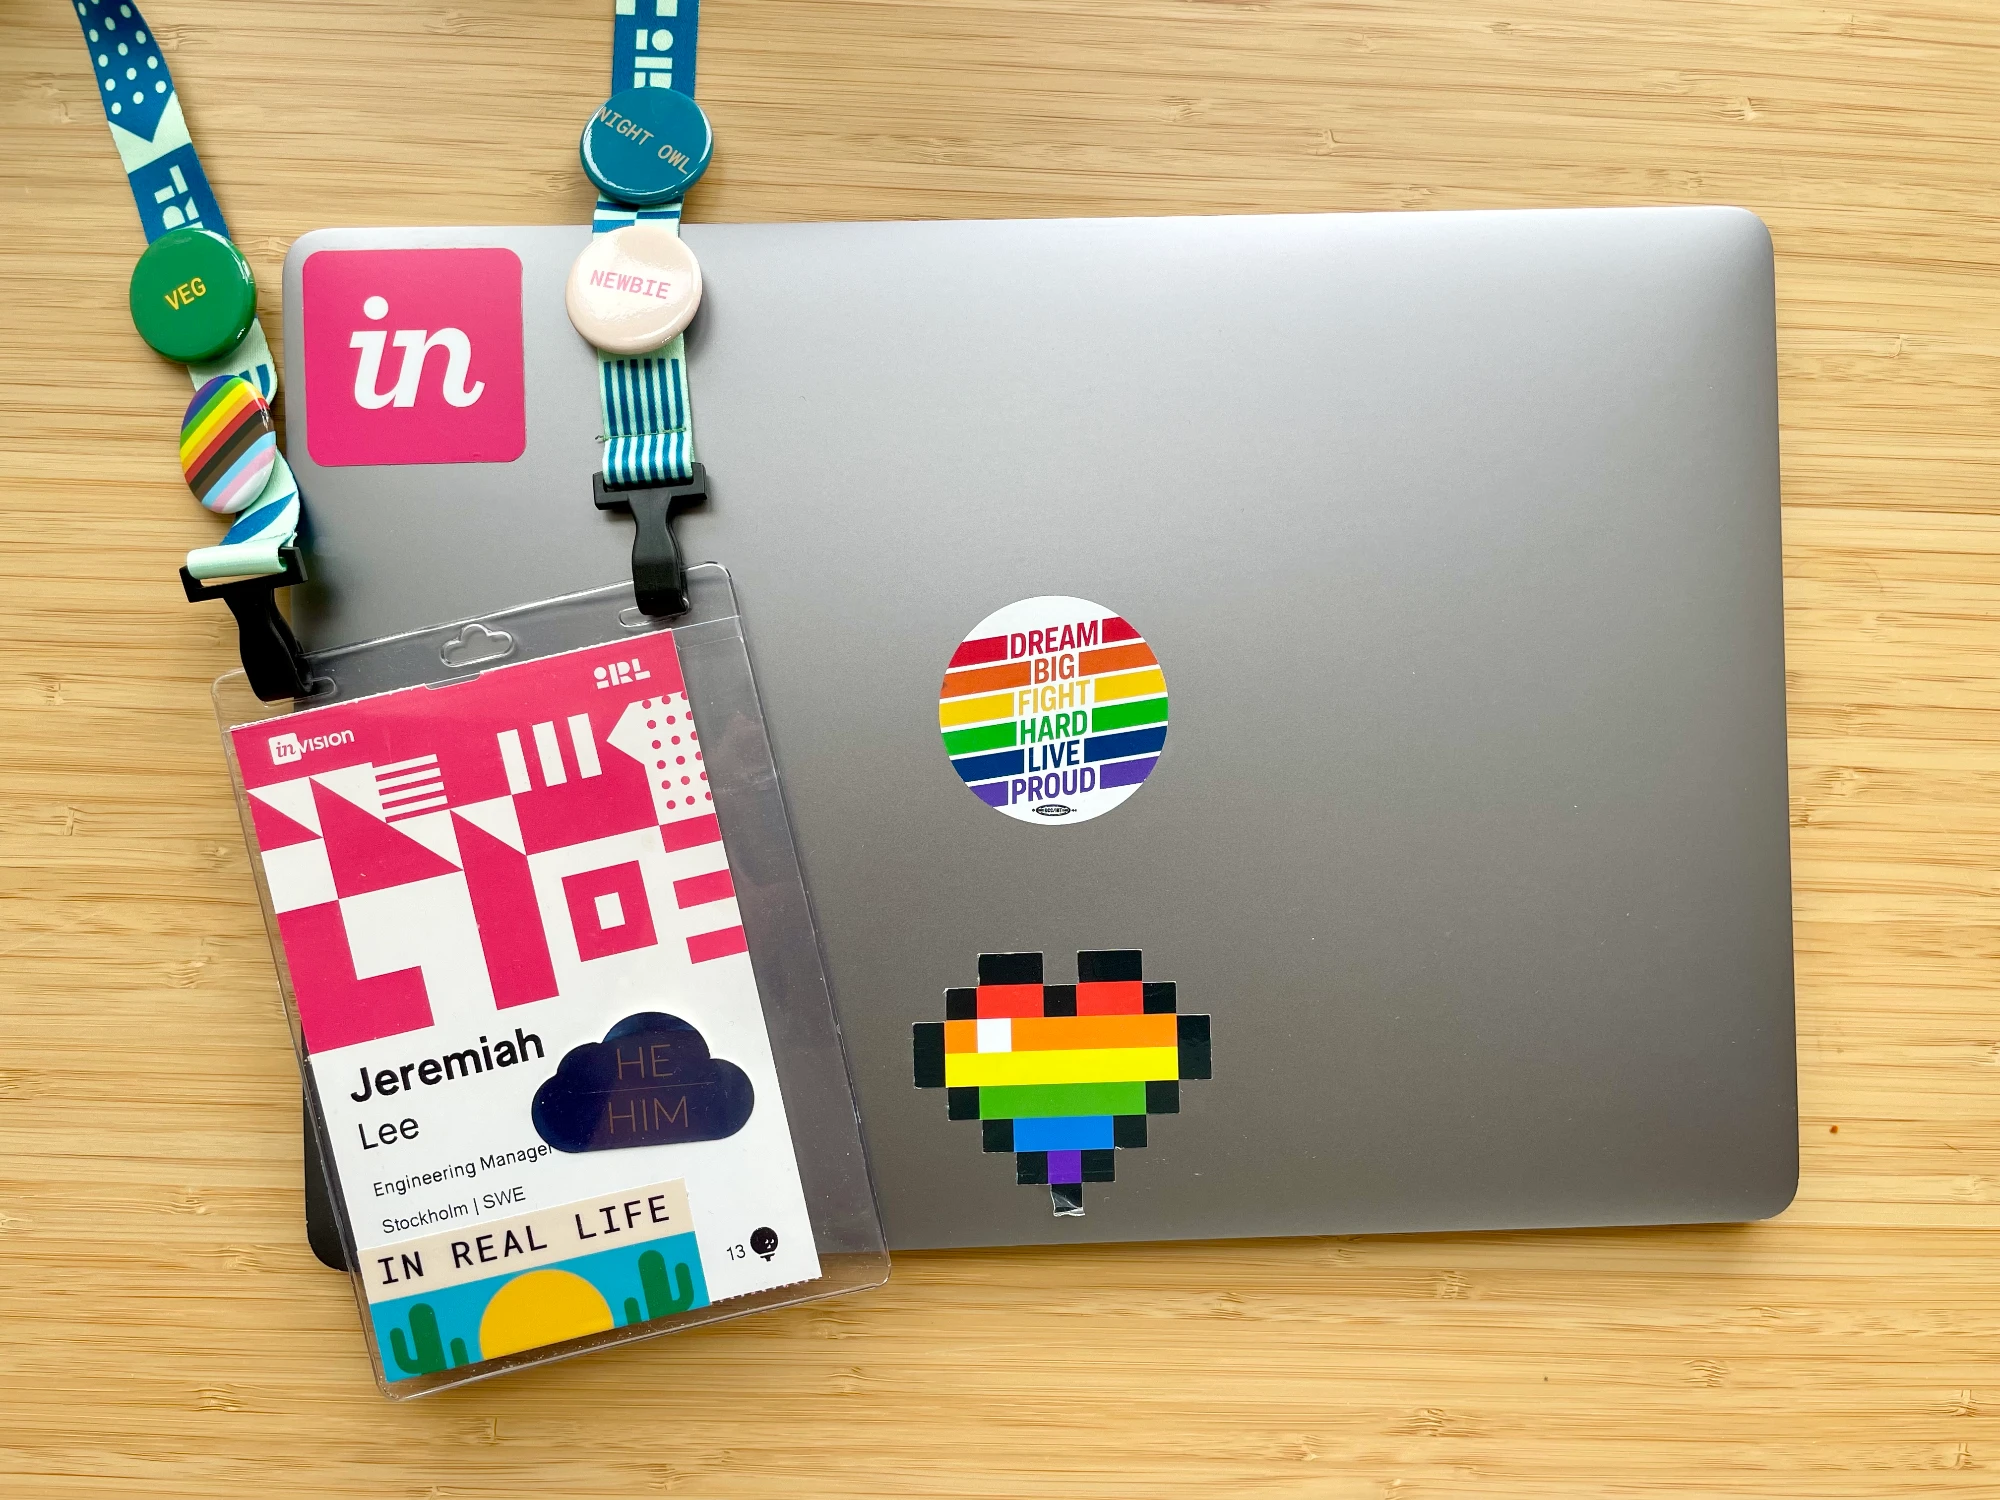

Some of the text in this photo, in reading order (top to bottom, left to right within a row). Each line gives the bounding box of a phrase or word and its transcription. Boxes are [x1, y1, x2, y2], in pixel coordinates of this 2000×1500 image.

[633, 29, 673, 88] IR
[597, 106, 690, 174] NIGHT OWL
[164, 277, 206, 310] VEG
[589, 269, 671, 299] NEWBIE
[349, 296, 485, 409] in
[1010, 620, 1098, 659] DREAM
[1034, 654, 1075, 684] BIG
[1018, 680, 1090, 716] FIGHT
[1020, 710, 1088, 745] HARD
[1028, 740, 1080, 773] LIVE
[1011, 766, 1095, 804] PROUD
[350, 1028, 545, 1102] Jeremiah
[616, 1044, 673, 1080] HE
[608, 1095, 689, 1134] HIM
[358, 1118, 419, 1150] Lee
[373, 1162, 477, 1196] Engineering
[382, 1204, 469, 1233] Stockholm
[483, 1186, 526, 1209] SWE
[377, 1194, 669, 1284] IN REAL LIFE
[727, 1244, 745, 1260] 13
